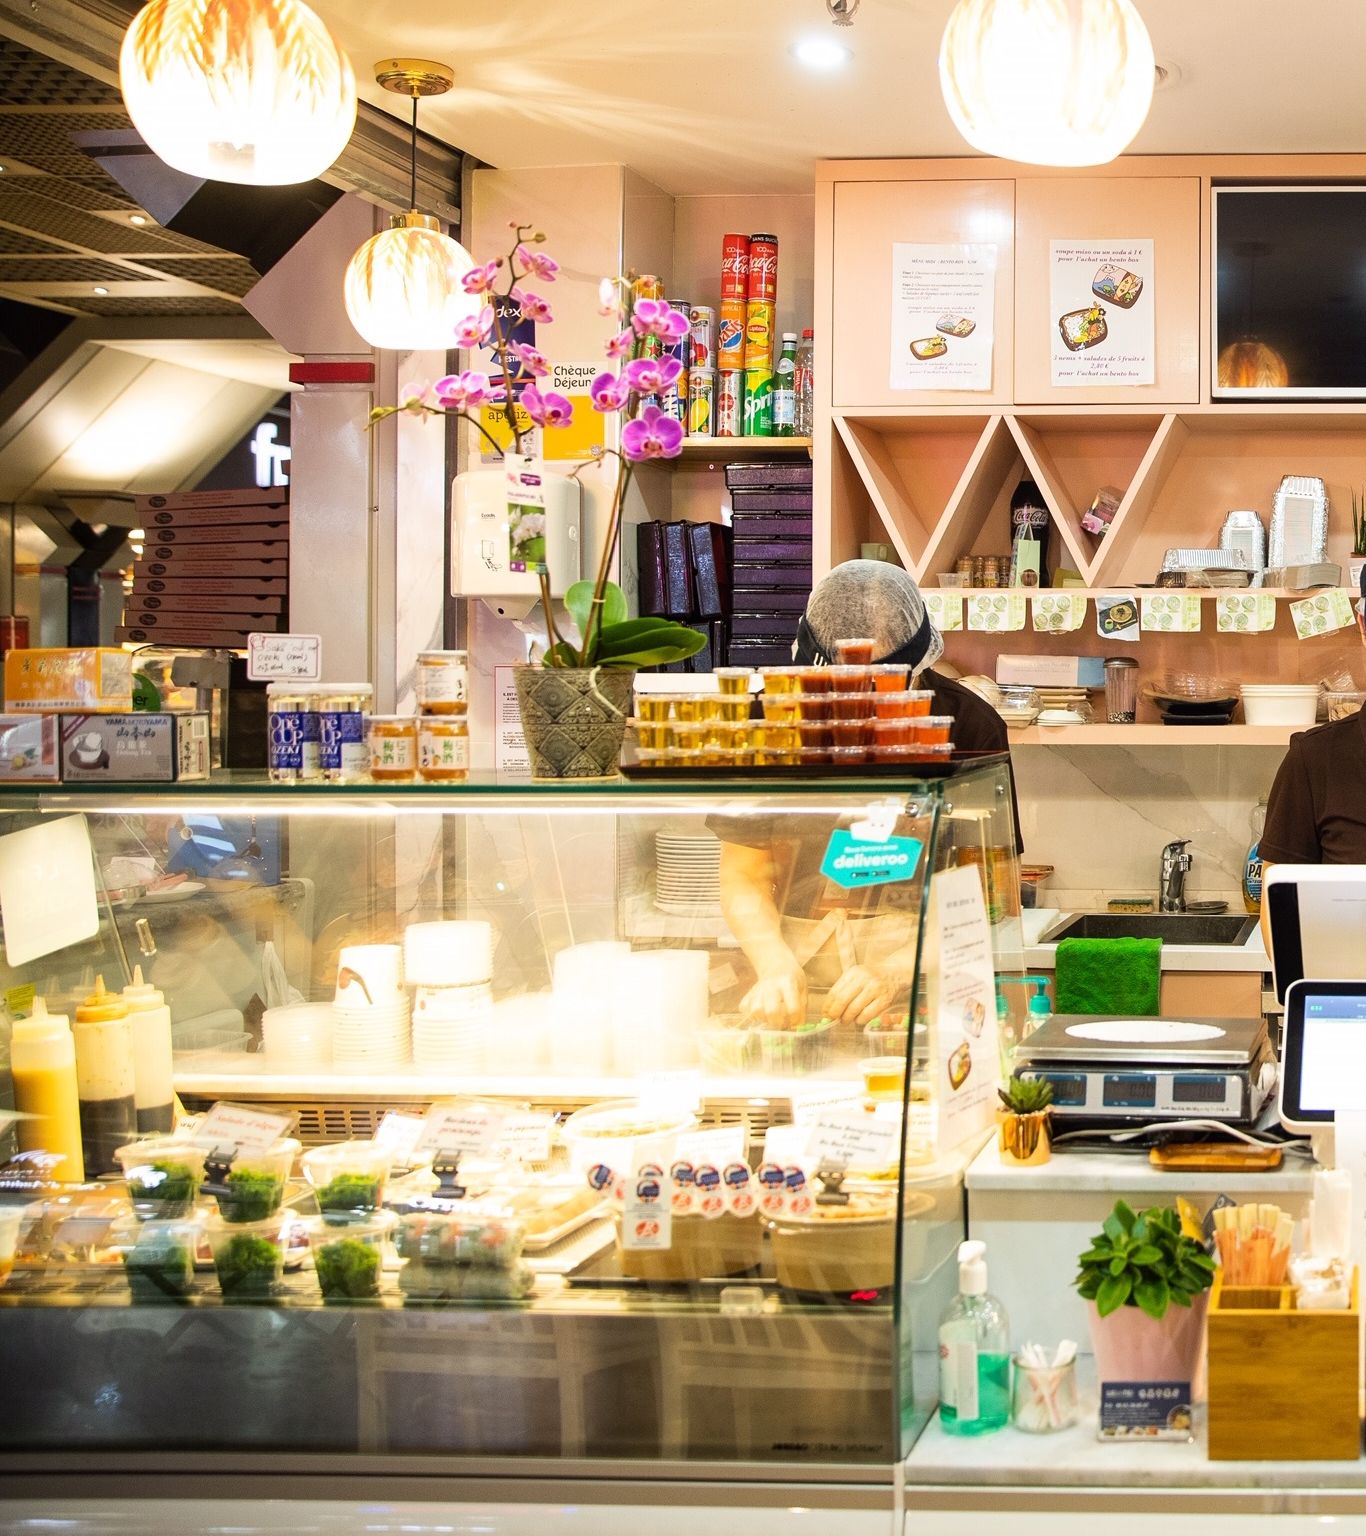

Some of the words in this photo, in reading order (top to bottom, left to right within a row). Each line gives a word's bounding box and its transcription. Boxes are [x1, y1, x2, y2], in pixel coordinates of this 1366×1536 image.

[553, 365, 597, 377] Chèque
[553, 377, 592, 390] Déjeun
[833, 853, 909, 869] deliveroo
